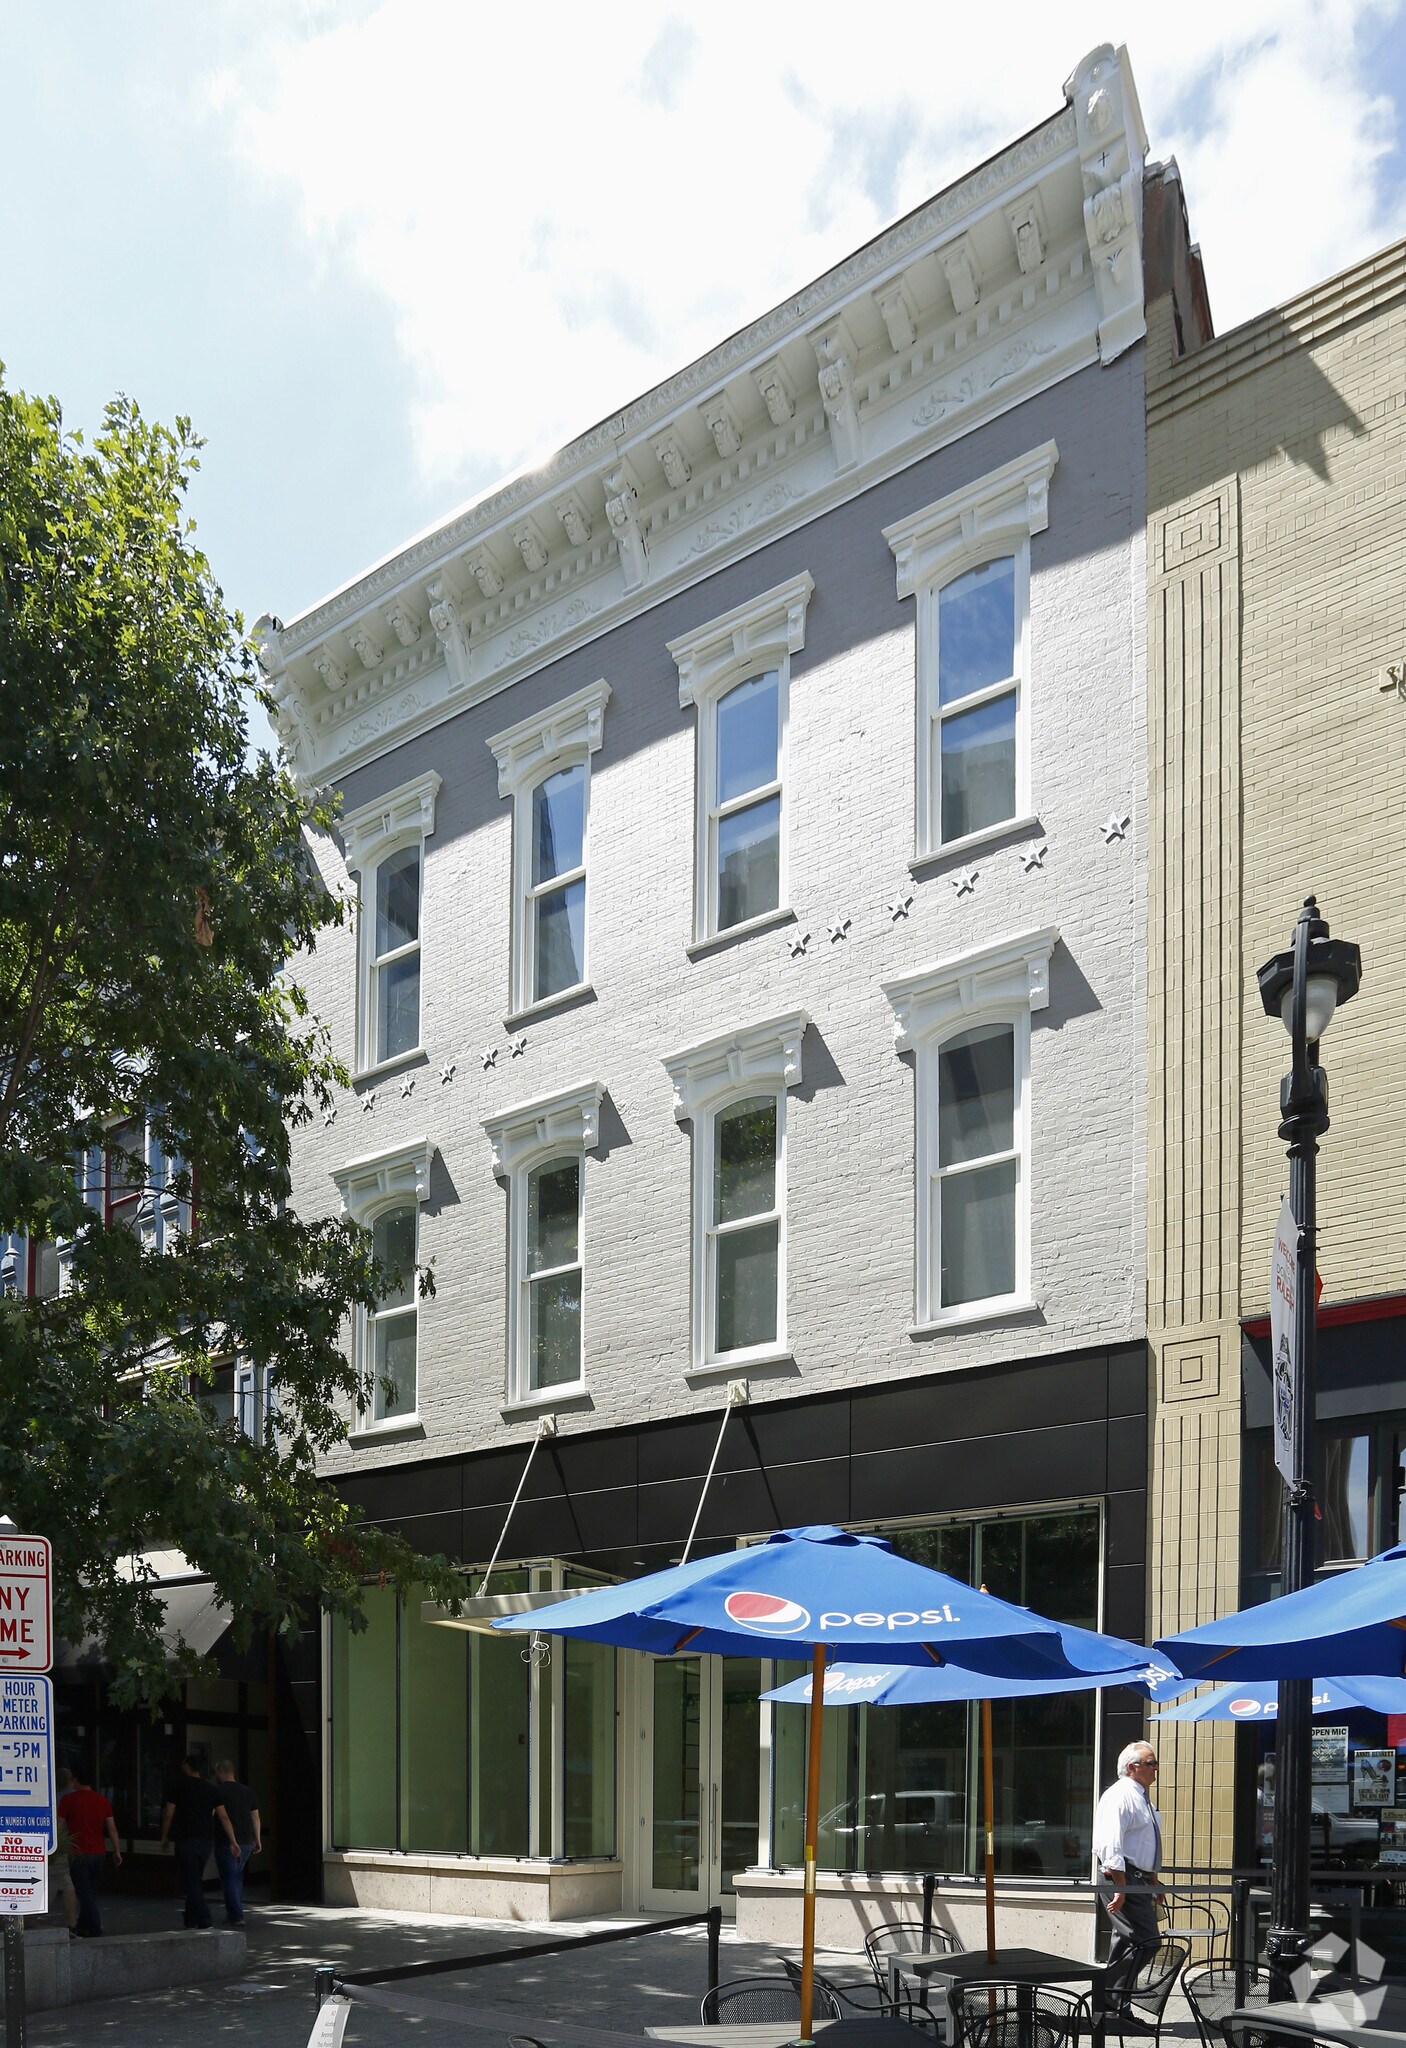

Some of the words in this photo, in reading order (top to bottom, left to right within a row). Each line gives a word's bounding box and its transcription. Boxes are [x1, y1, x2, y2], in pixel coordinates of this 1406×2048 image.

[5, 1681, 36, 1696] HOUR
[3, 1698, 38, 1713] METER
[1331, 1728, 1347, 1736] MIC
[5, 1816, 27, 1827] NUMBER
[36, 1817, 51, 1827] CURB
[4, 1837, 23, 1845] NO
[0, 1845, 43, 1855] RKING
[0, 1887, 34, 1895] OLICE
